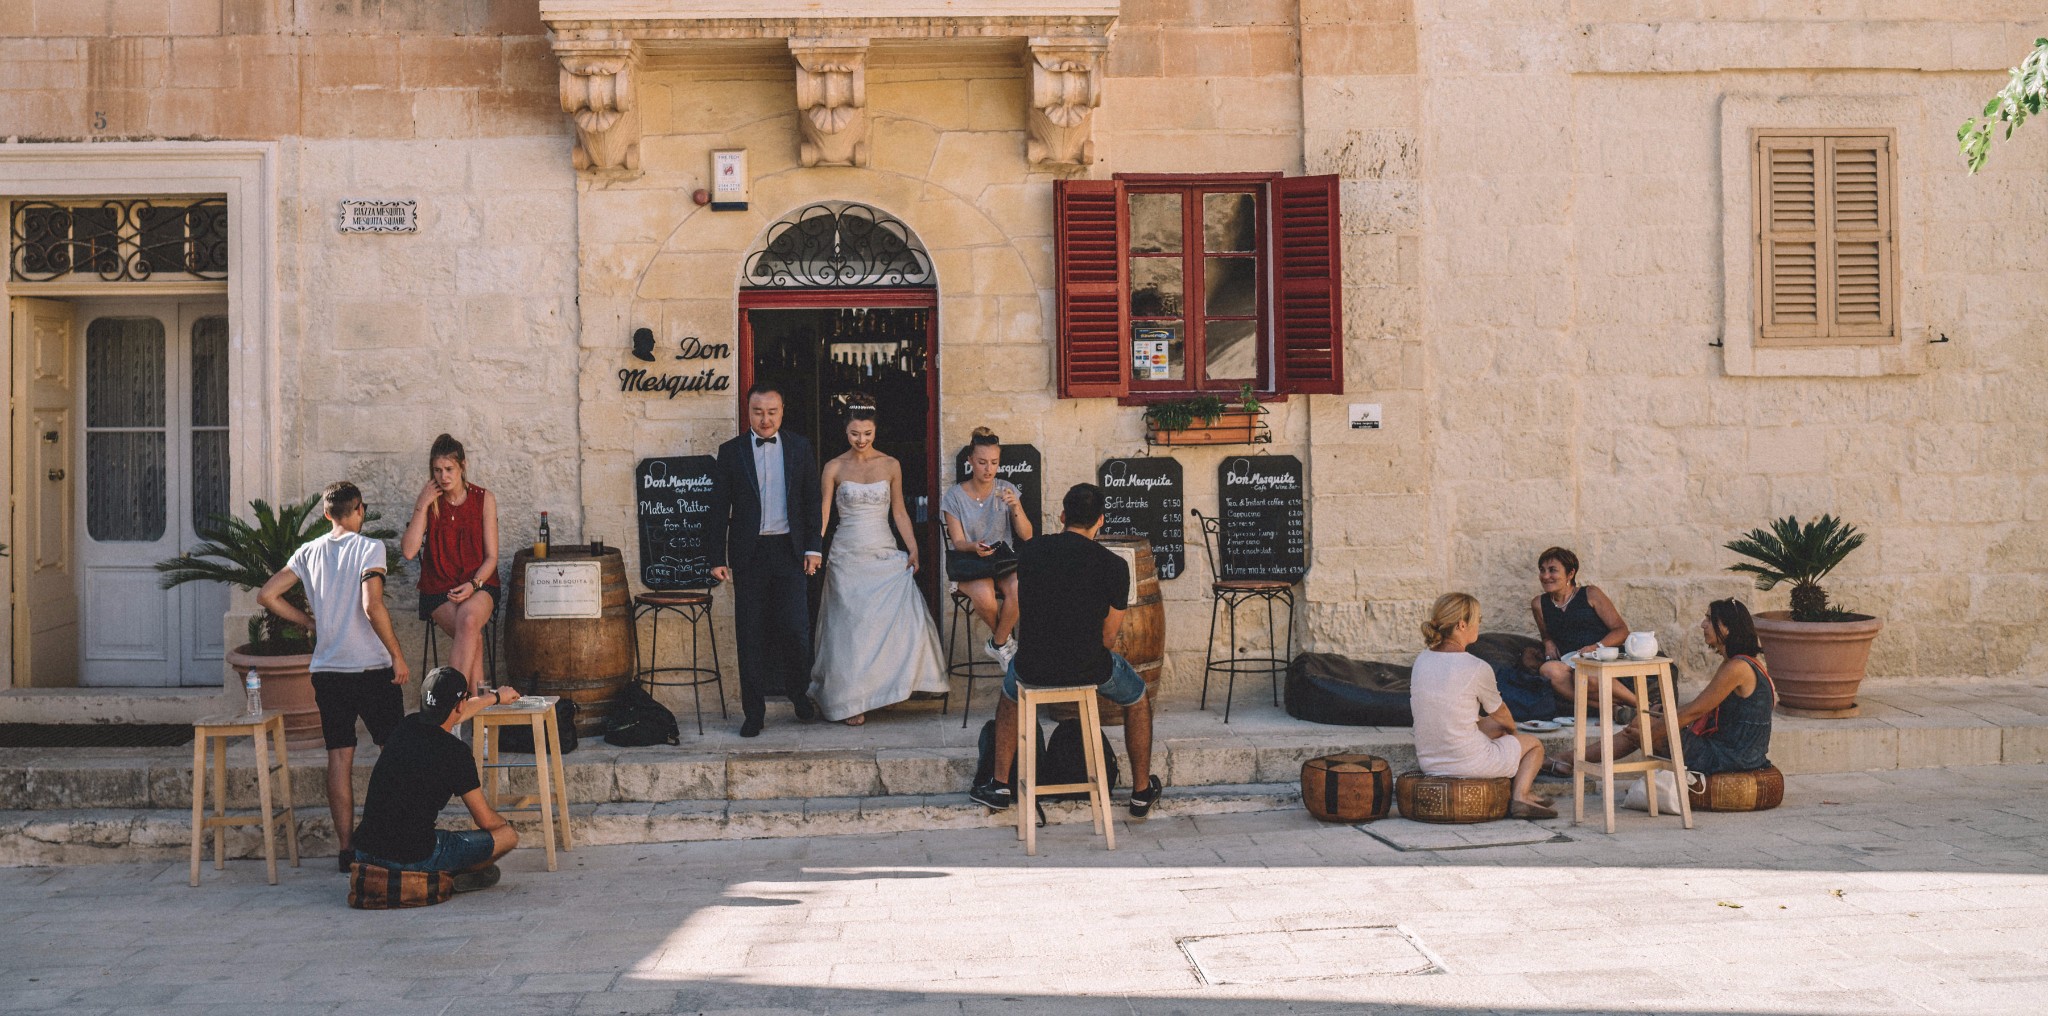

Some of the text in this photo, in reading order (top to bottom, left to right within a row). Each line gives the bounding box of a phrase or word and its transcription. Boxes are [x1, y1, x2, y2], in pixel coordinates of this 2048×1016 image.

[94, 111, 107, 130] 5
[354, 207, 406, 216] PIAZZA MESQUITA
[352, 216, 406, 226] MESQUITA SQUARE
[675, 336, 731, 360] Don
[618, 368, 730, 400] Mesquita
[996, 460, 1033, 478] esquita
[644, 473, 714, 491] Don Mesquita
[1104, 473, 1173, 491] Don Mesquita
[1226, 471, 1296, 488] Don Mesquita
[640, 498, 711, 516] Maltese Platter
[1104, 496, 1181, 510] Soft drinks €1.50
[1226, 498, 1238, 507] Tea
[1238, 498, 1245, 506] &
[1245, 498, 1266, 507] Instant
[1267, 498, 1284, 506] coffee
[663, 518, 680, 532] for
[1104, 513, 1131, 524] Juices
[426, 690, 437, 706] LA
